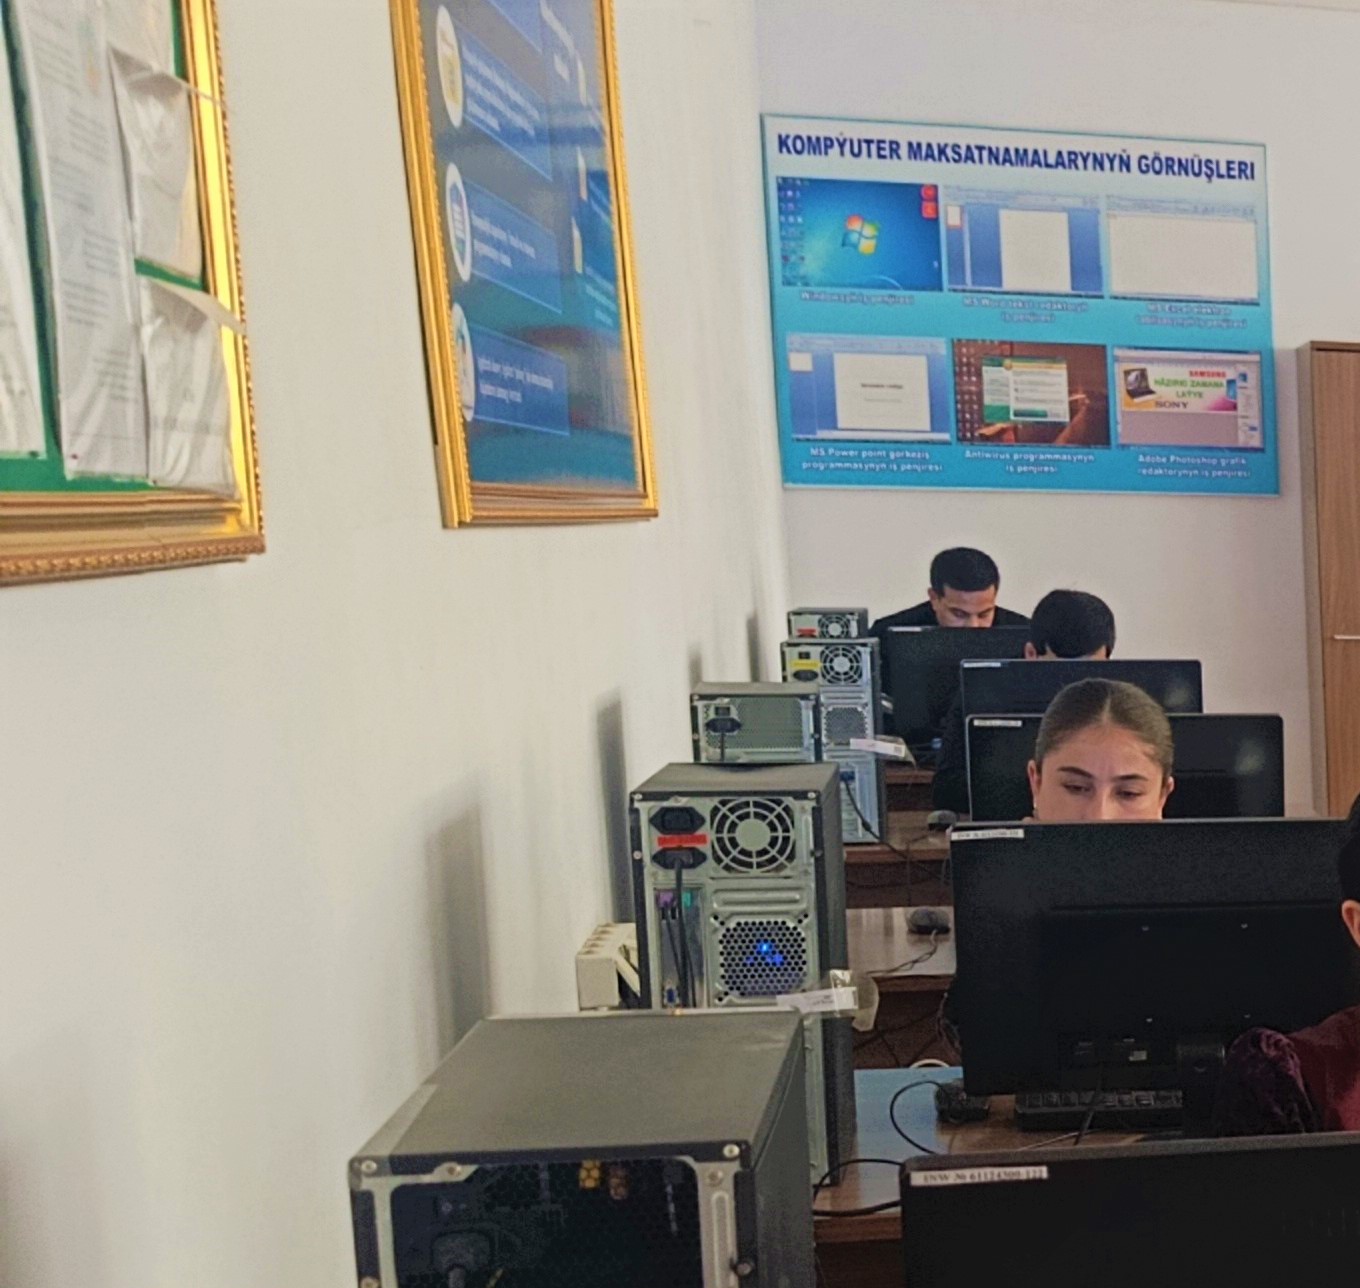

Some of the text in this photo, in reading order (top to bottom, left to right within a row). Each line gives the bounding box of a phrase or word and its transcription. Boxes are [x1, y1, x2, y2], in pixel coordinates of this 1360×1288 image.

[777, 132, 1255, 184] KOMPÝUTER MAKSATNAMALARYNYŇ GÖRNÜŞLERI
[1188, 370, 1227, 378] SAMSUNG
[1155, 400, 1188, 409] SONY
[810, 447, 825, 457] MS
[828, 448, 858, 458] Power
[964, 449, 1010, 460] Antiwirus
[1138, 454, 1167, 464] Adobe
[1170, 455, 1218, 466] Photoshop
